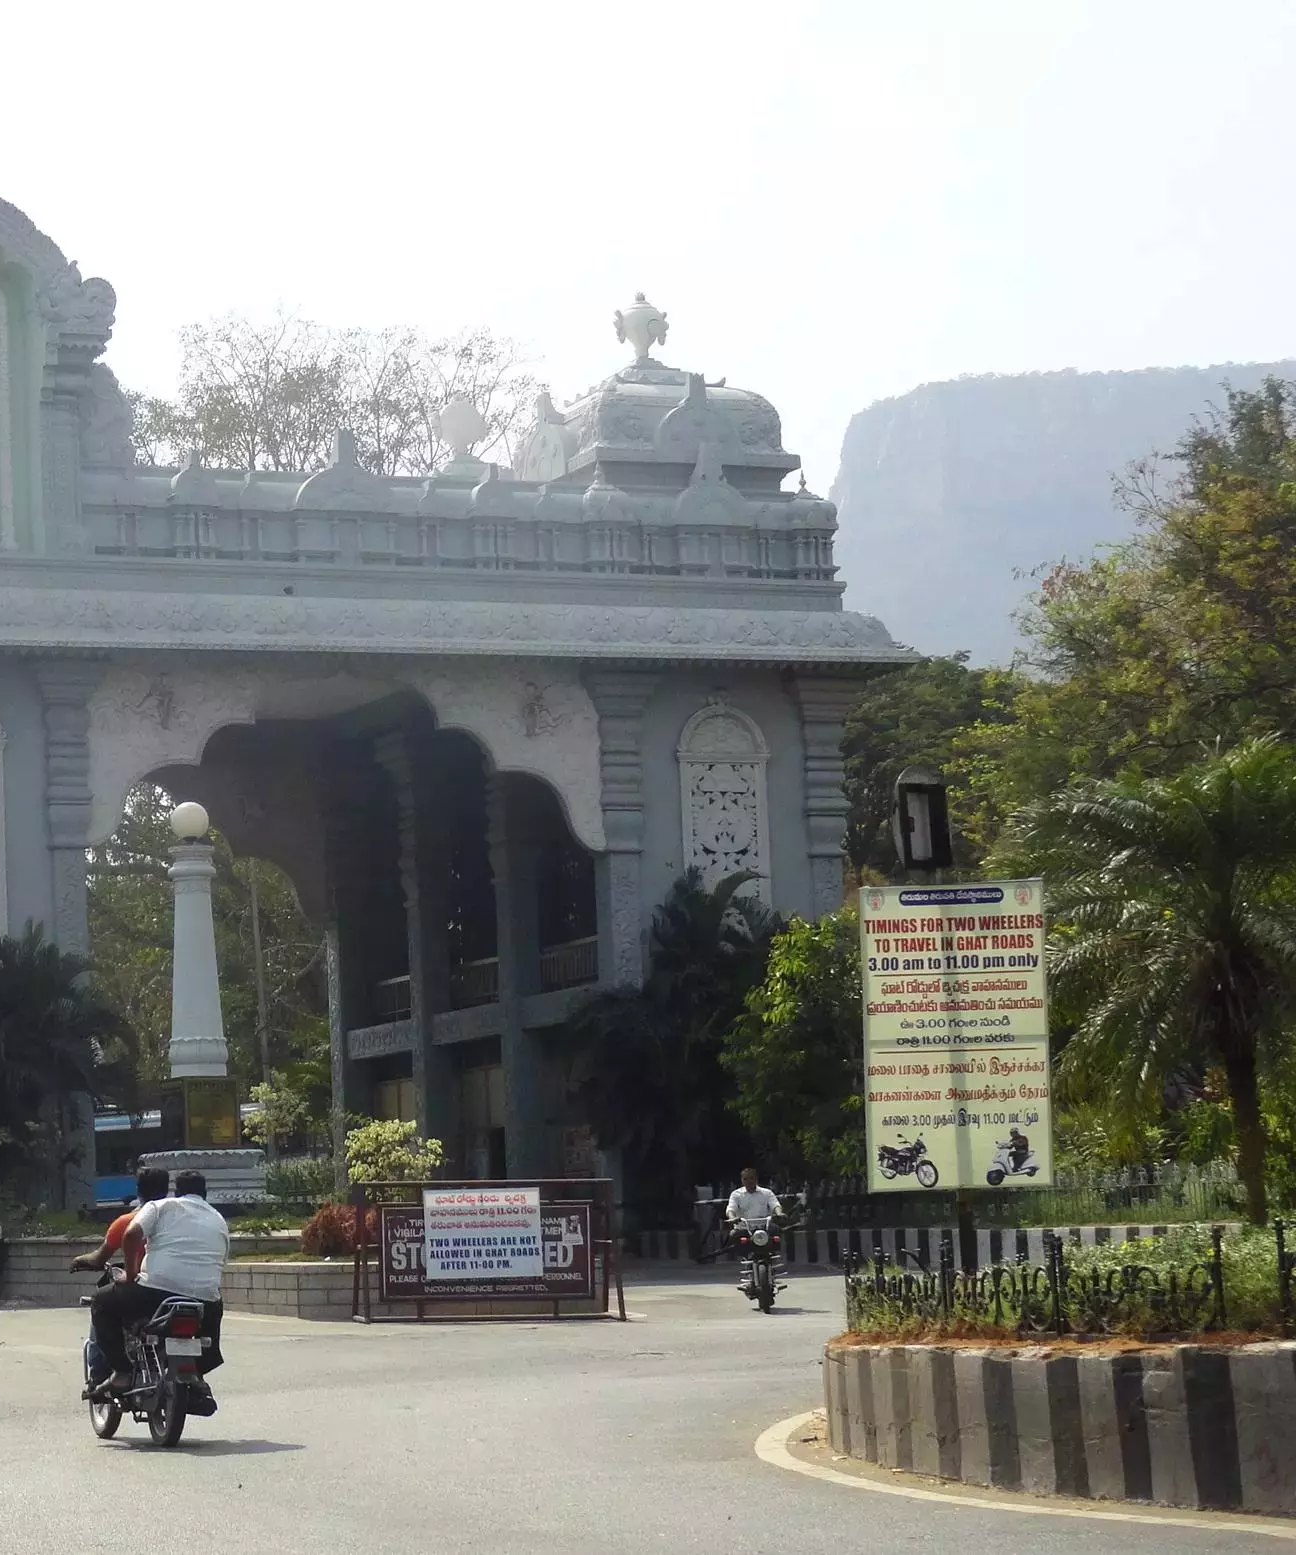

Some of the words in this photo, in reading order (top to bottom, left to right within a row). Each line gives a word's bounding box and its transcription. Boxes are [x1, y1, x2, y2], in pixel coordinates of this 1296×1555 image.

[864, 919, 917, 934] TIMINGS
[921, 918, 943, 933] FOR
[946, 916, 975, 932] TWO
[978, 914, 1044, 931] WHEELERS
[874, 938, 890, 953] TO
[893, 937, 937, 953] TRAVEL
[941, 936, 953, 951] IN
[956, 935, 989, 950] GHAT
[992, 934, 1034, 949] ROADS
[868, 957, 899, 972] 3.00
[902, 958, 924, 970] am
[927, 956, 942, 970] to
[944, 954, 979, 969] 11.00
[983, 956, 1005, 969] pm
[1008, 953, 1039, 968] only
[915, 1017, 946, 1029] 3.00
[979, 1015, 1011, 1027] నుండి
[896, 1035, 920, 1048] రాత్రి
[922, 1034, 951, 1045] 11.00
[985, 1033, 1015, 1044] వరకు
[868, 1064, 896, 1076] மலை
[899, 1063, 930, 1077] பாதை
[932, 1058, 986, 1075] சாலையில்
[1019, 1083, 1049, 1100] நேரம்
[882, 1114, 910, 1126] காலை
[912, 1114, 931, 1126] 3.00
[983, 1112, 1005, 1125] 11.00
[429, 1239, 450, 1248] TWO
[452, 1237, 498, 1247] WHEELERS
[500, 1236, 517, 1246] ARE
[520, 1235, 537, 1245] NOT
[429, 1249, 470, 1259] ALLOWED
[473, 1249, 482, 1258] IN
[485, 1248, 507, 1257] GHAT
[510, 1247, 541, 1257] ROADS
[440, 1260, 467, 1270] AFTER
[469, 1260, 494, 1270] 11-00
[496, 1259, 513, 1269] PM.
[389, 1274, 419, 1283] PLEASE
[424, 1284, 493, 1293] INCONVENIENCE
